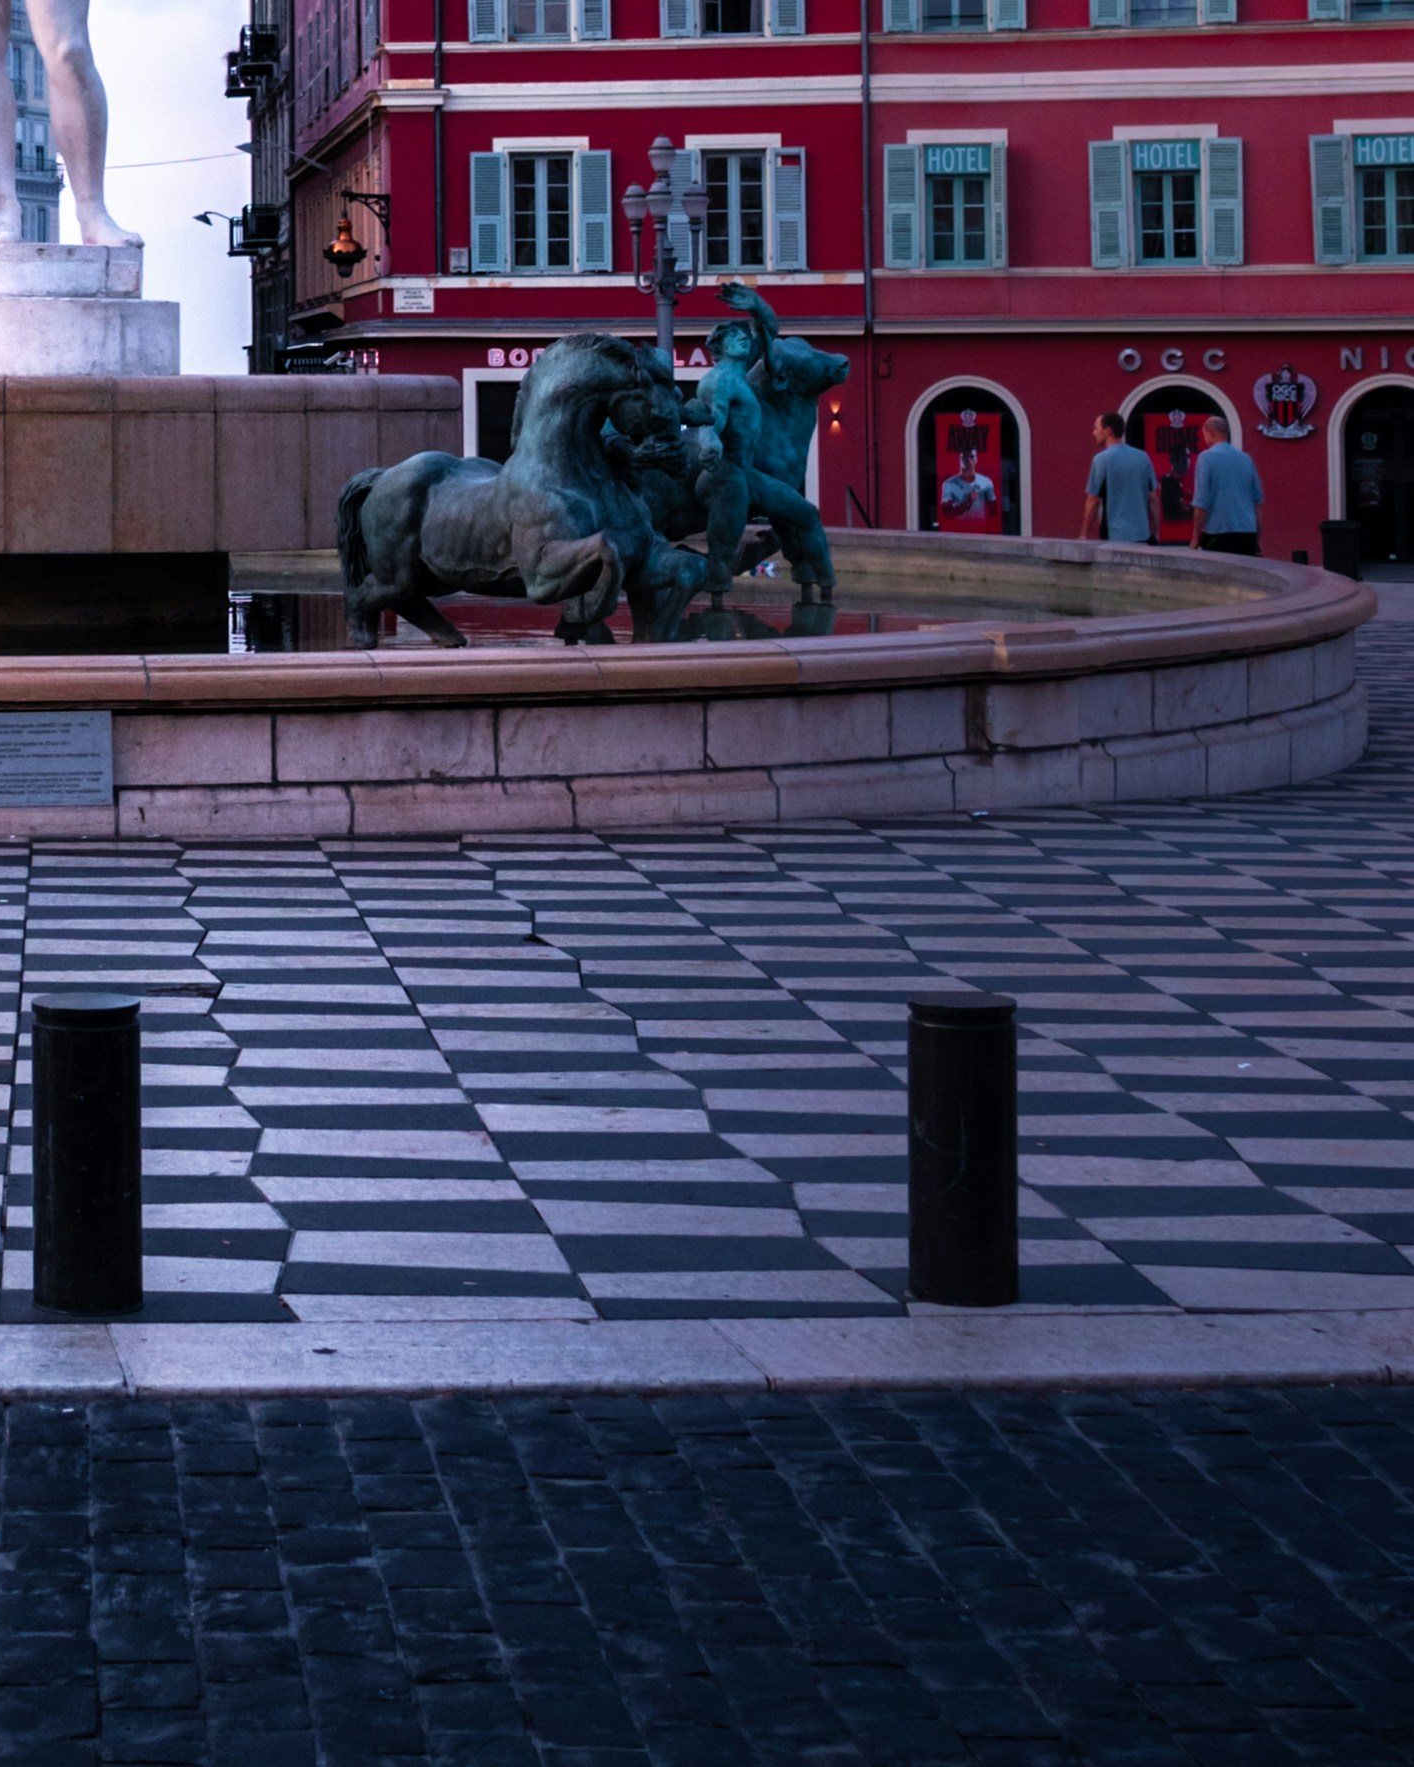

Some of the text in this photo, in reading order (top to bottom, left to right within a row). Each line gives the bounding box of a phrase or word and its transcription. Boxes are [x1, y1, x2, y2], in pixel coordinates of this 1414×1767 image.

[928, 147, 989, 173] HOTEL
[1134, 142, 1198, 170] HOTEL
[1117, 347, 1226, 372] OGC
[947, 424, 989, 453] AWAY
